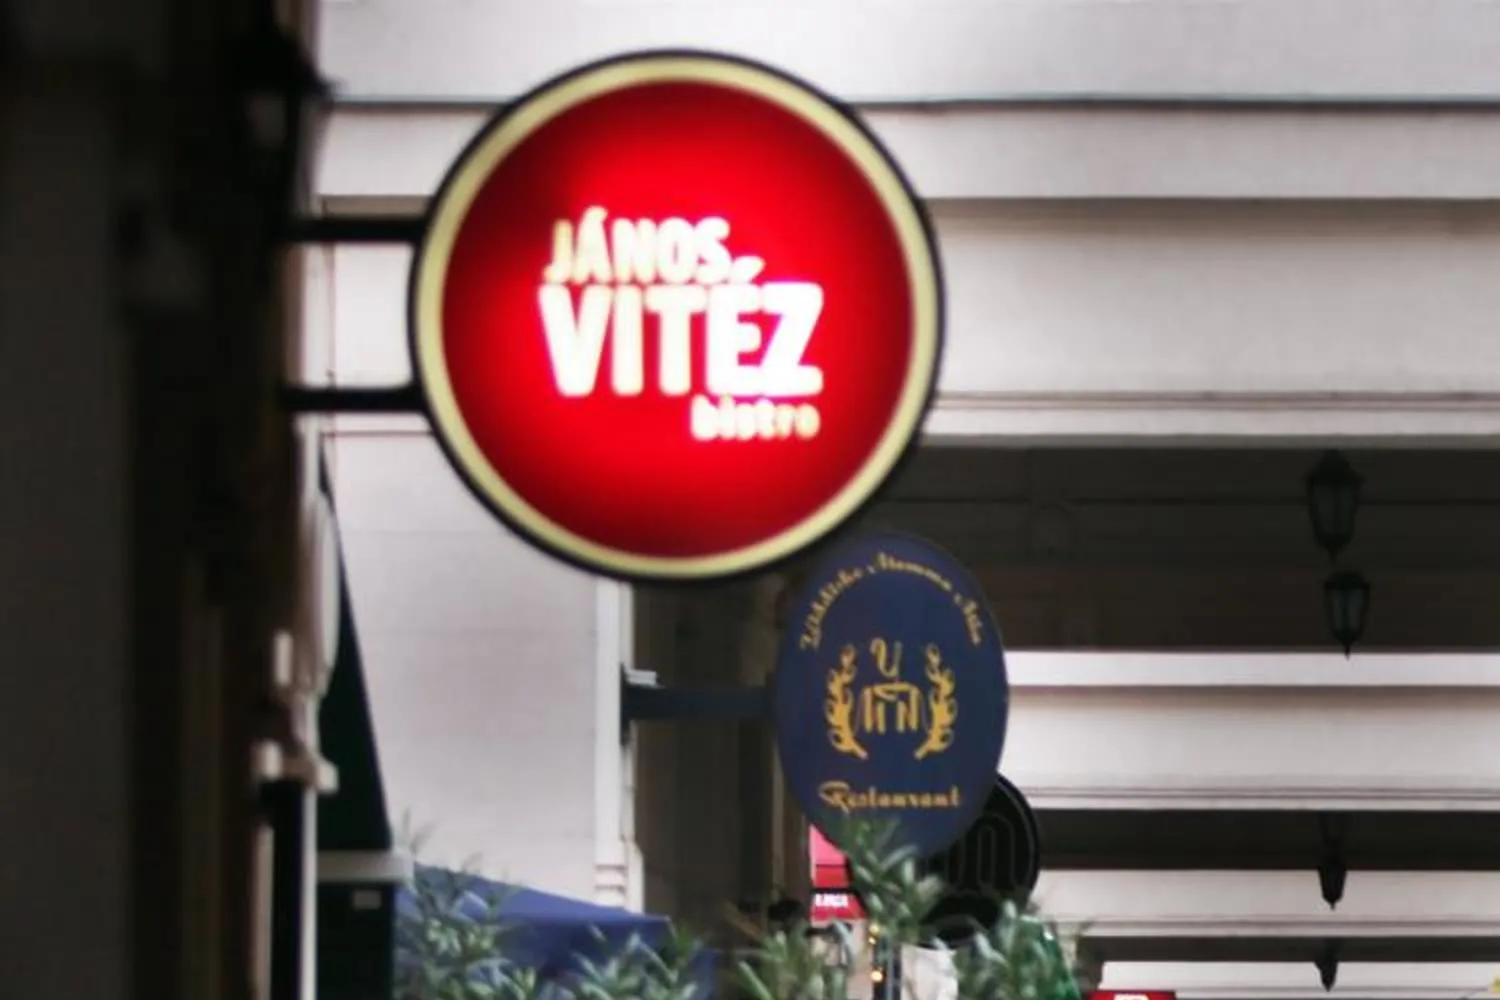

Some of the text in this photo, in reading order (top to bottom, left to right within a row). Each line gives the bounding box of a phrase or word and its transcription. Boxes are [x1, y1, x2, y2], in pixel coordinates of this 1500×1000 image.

[544, 206, 731, 285] JÁNOS
[691, 395, 820, 441] bistro
[819, 781, 959, 812] Restaurant
